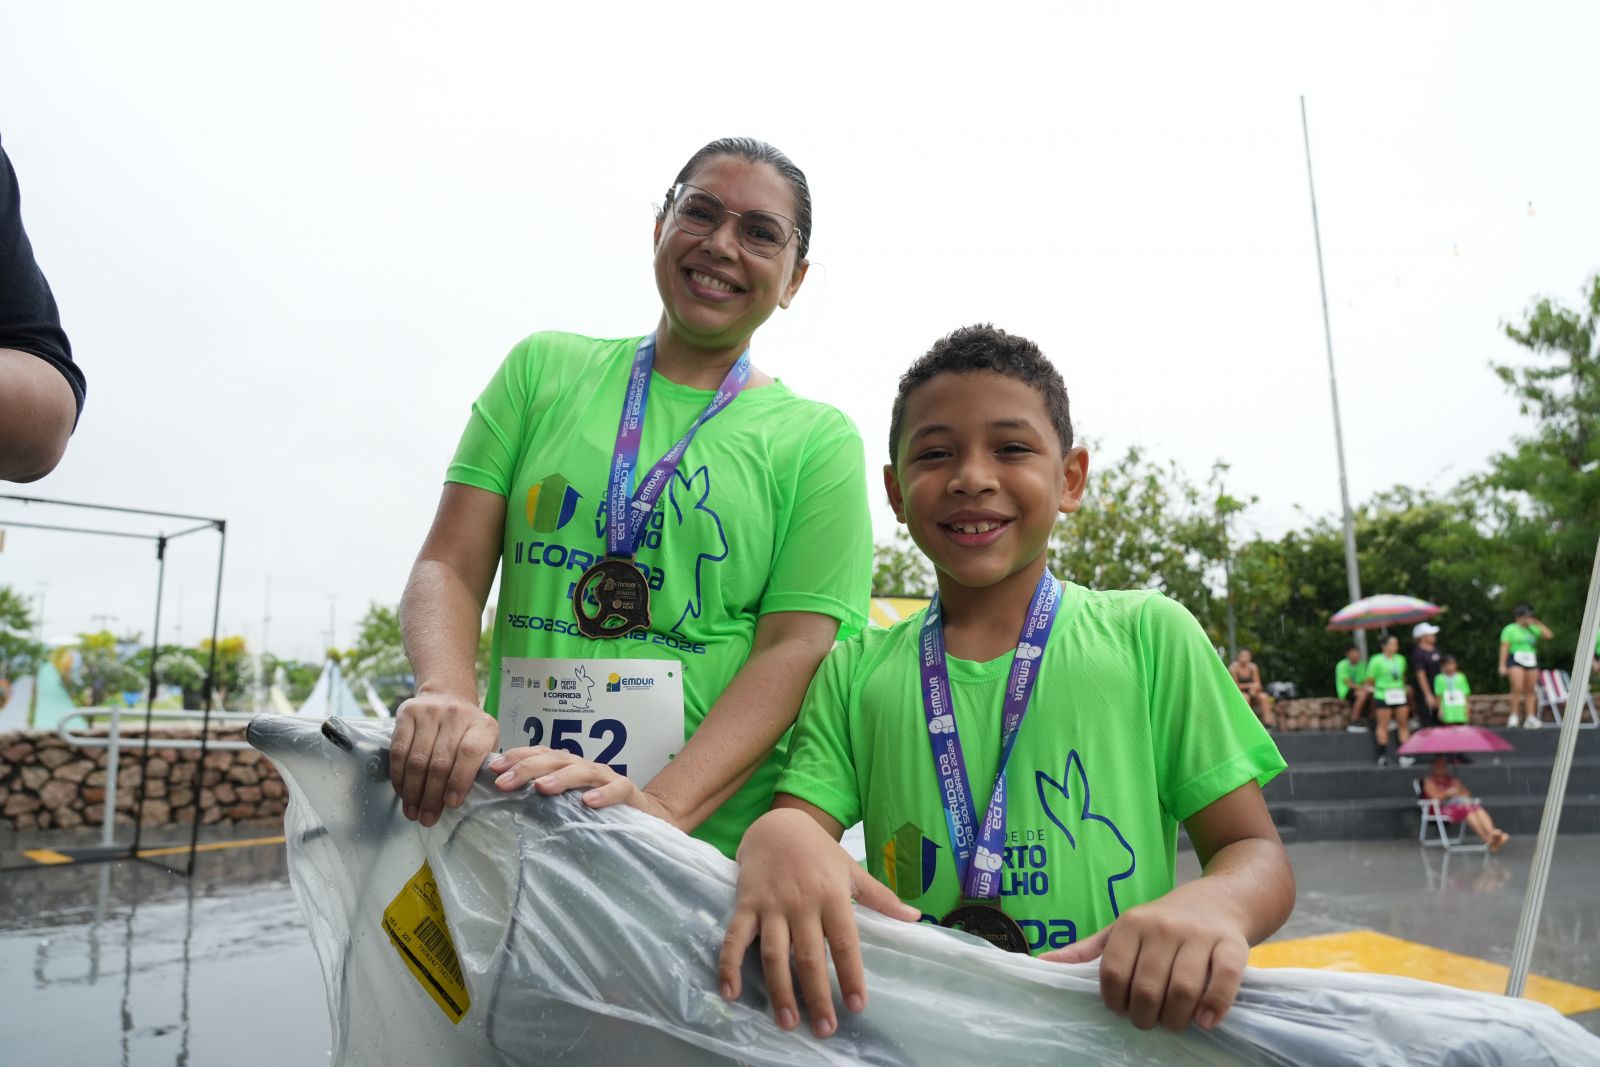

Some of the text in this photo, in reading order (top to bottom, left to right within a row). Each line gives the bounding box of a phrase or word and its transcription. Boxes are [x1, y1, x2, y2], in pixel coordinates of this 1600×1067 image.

[618, 470, 629, 520] CORRIDA
[640, 469, 664, 500] EMDUR
[618, 522, 626, 540] DA
[1026, 617, 1038, 638] 2026
[1036, 613, 1049, 630] DA
[652, 632, 706, 654] 2026
[924, 631, 934, 667] SEMTEL
[1014, 660, 1030, 702] EMDUR
[929, 676, 943, 716] EMDUR
[940, 754, 952, 776] DA
[946, 739, 958, 766] 2026
[944, 778, 966, 847] CORRIDA
[992, 807, 1002, 830] DA
[984, 813, 994, 841] 2026
[1026, 830, 1046, 840] DE
[1002, 844, 1046, 869] RTO
[1000, 871, 1048, 896] LHO
